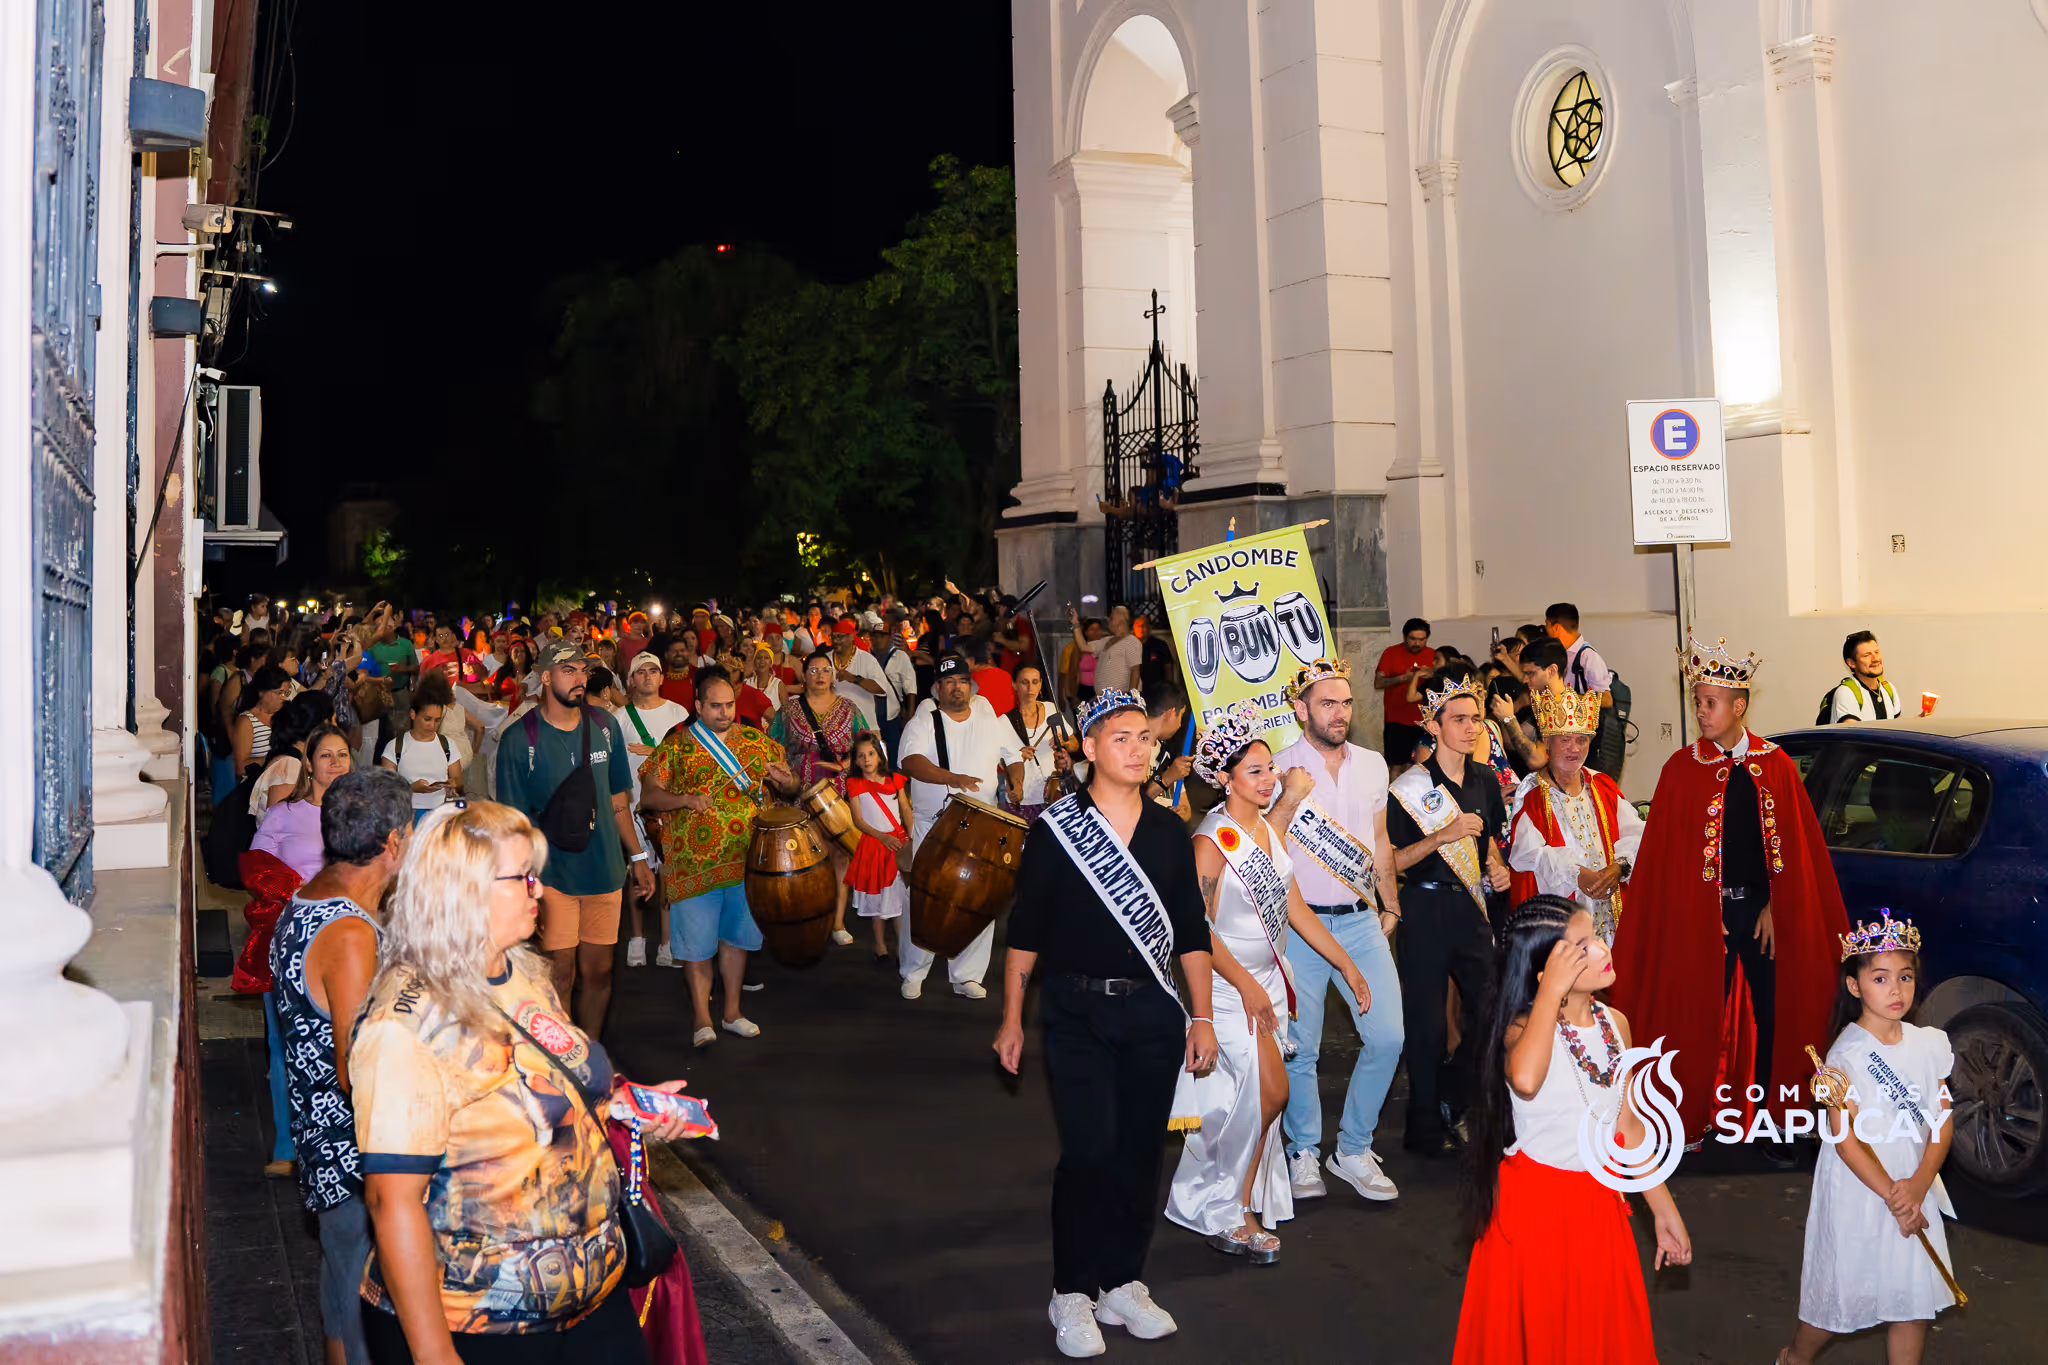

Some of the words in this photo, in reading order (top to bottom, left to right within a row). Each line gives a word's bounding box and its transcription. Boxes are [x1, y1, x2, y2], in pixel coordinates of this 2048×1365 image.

[1663, 418, 1687, 450] E
[1633, 464, 1669, 473] ESPACIO
[1670, 463, 1721, 472] RESERVADO
[1170, 547, 1300, 595] CANDOMBE
[1046, 794, 1145, 906] EPRESENTANTE
[1288, 823, 1319, 854] Carnaval
[1317, 846, 1344, 872] Barrial
[1340, 863, 1360, 883] 2025
[1315, 818, 1363, 863] Representante
[1248, 847, 1287, 901] REPRESENTANTE
[1238, 861, 1267, 909] COMPARSA
[1262, 904, 1283, 943] OSIRIS
[1869, 1051, 1910, 1099] REPRESENTANTE
